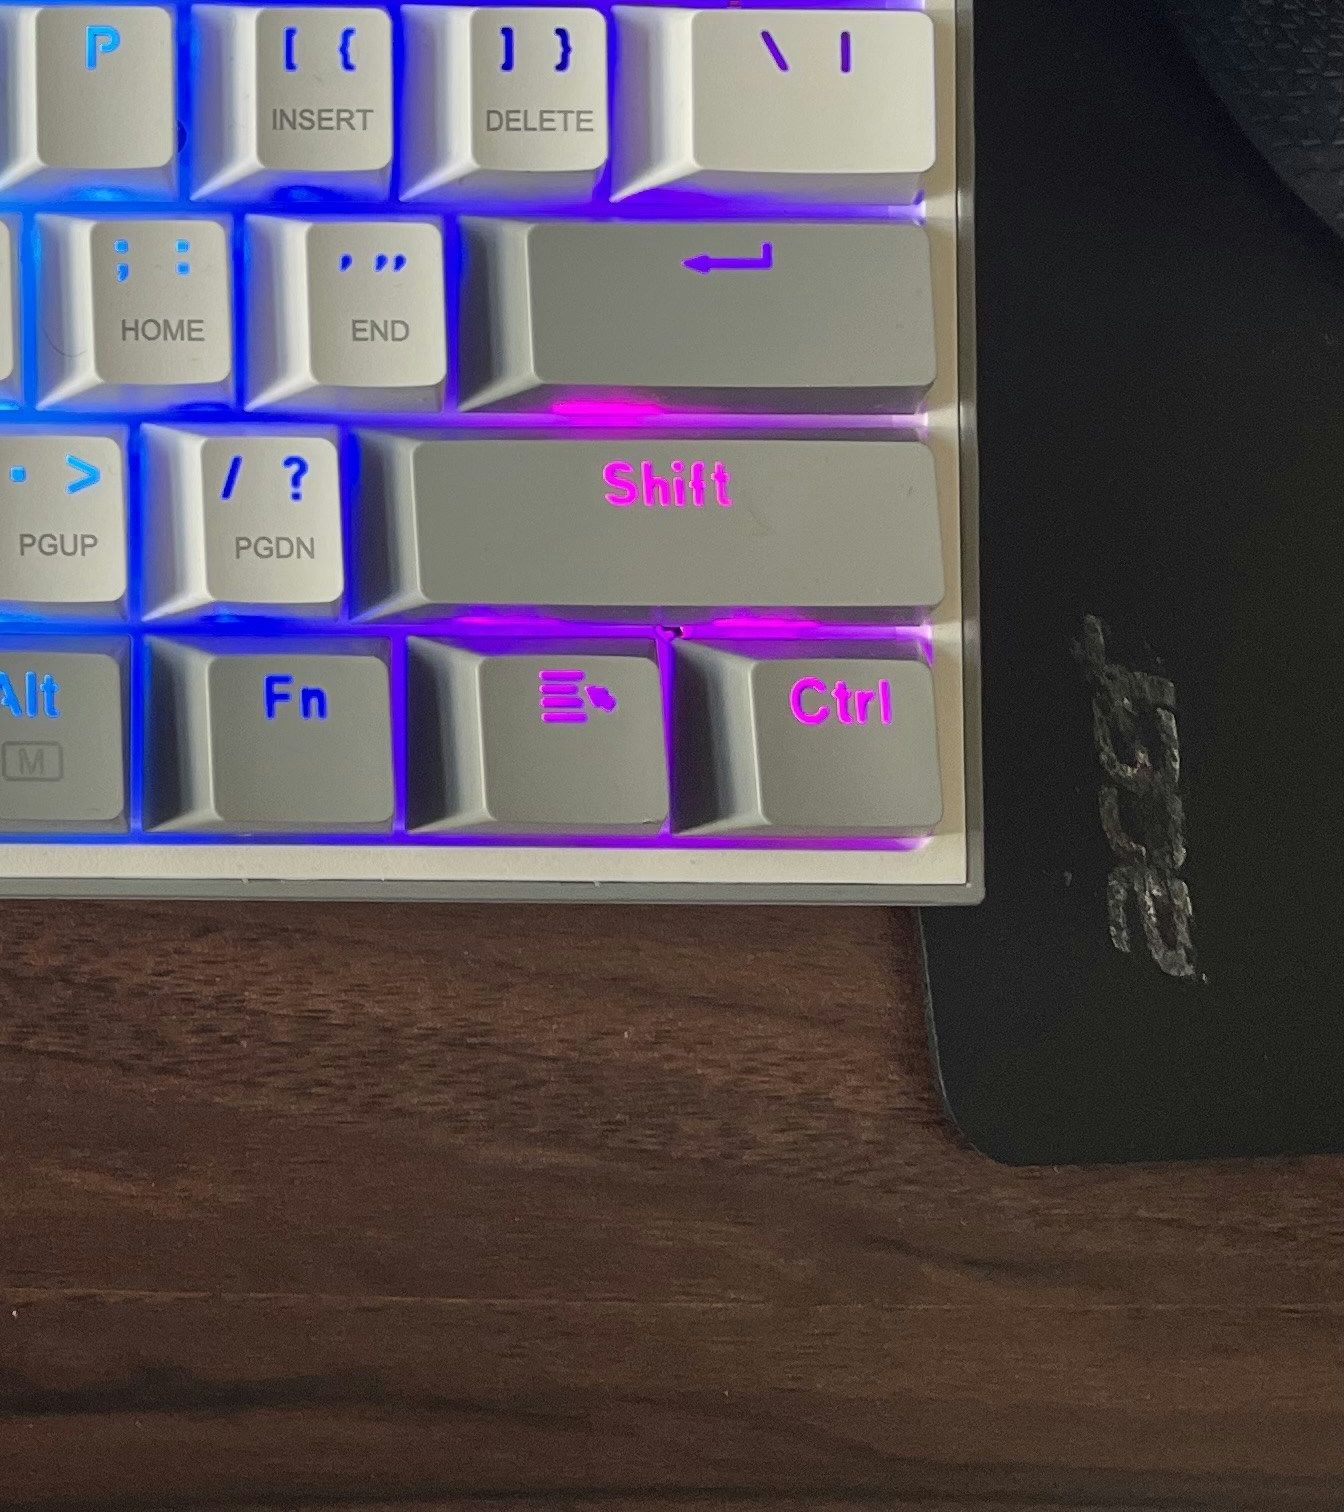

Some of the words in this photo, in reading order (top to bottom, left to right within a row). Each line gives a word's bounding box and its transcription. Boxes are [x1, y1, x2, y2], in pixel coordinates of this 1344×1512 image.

[86, 25, 121, 70] P
[272, 108, 374, 132] INSERT
[487, 110, 594, 133] DELETE
[121, 319, 205, 342] HOME
[351, 319, 409, 342] END
[282, 456, 309, 501] ?
[602, 460, 733, 508] Shift
[19, 534, 98, 558] PGUP
[235, 536, 316, 561] PGDN
[263, 674, 328, 720] Fn
[789, 676, 892, 727] Ctrl
